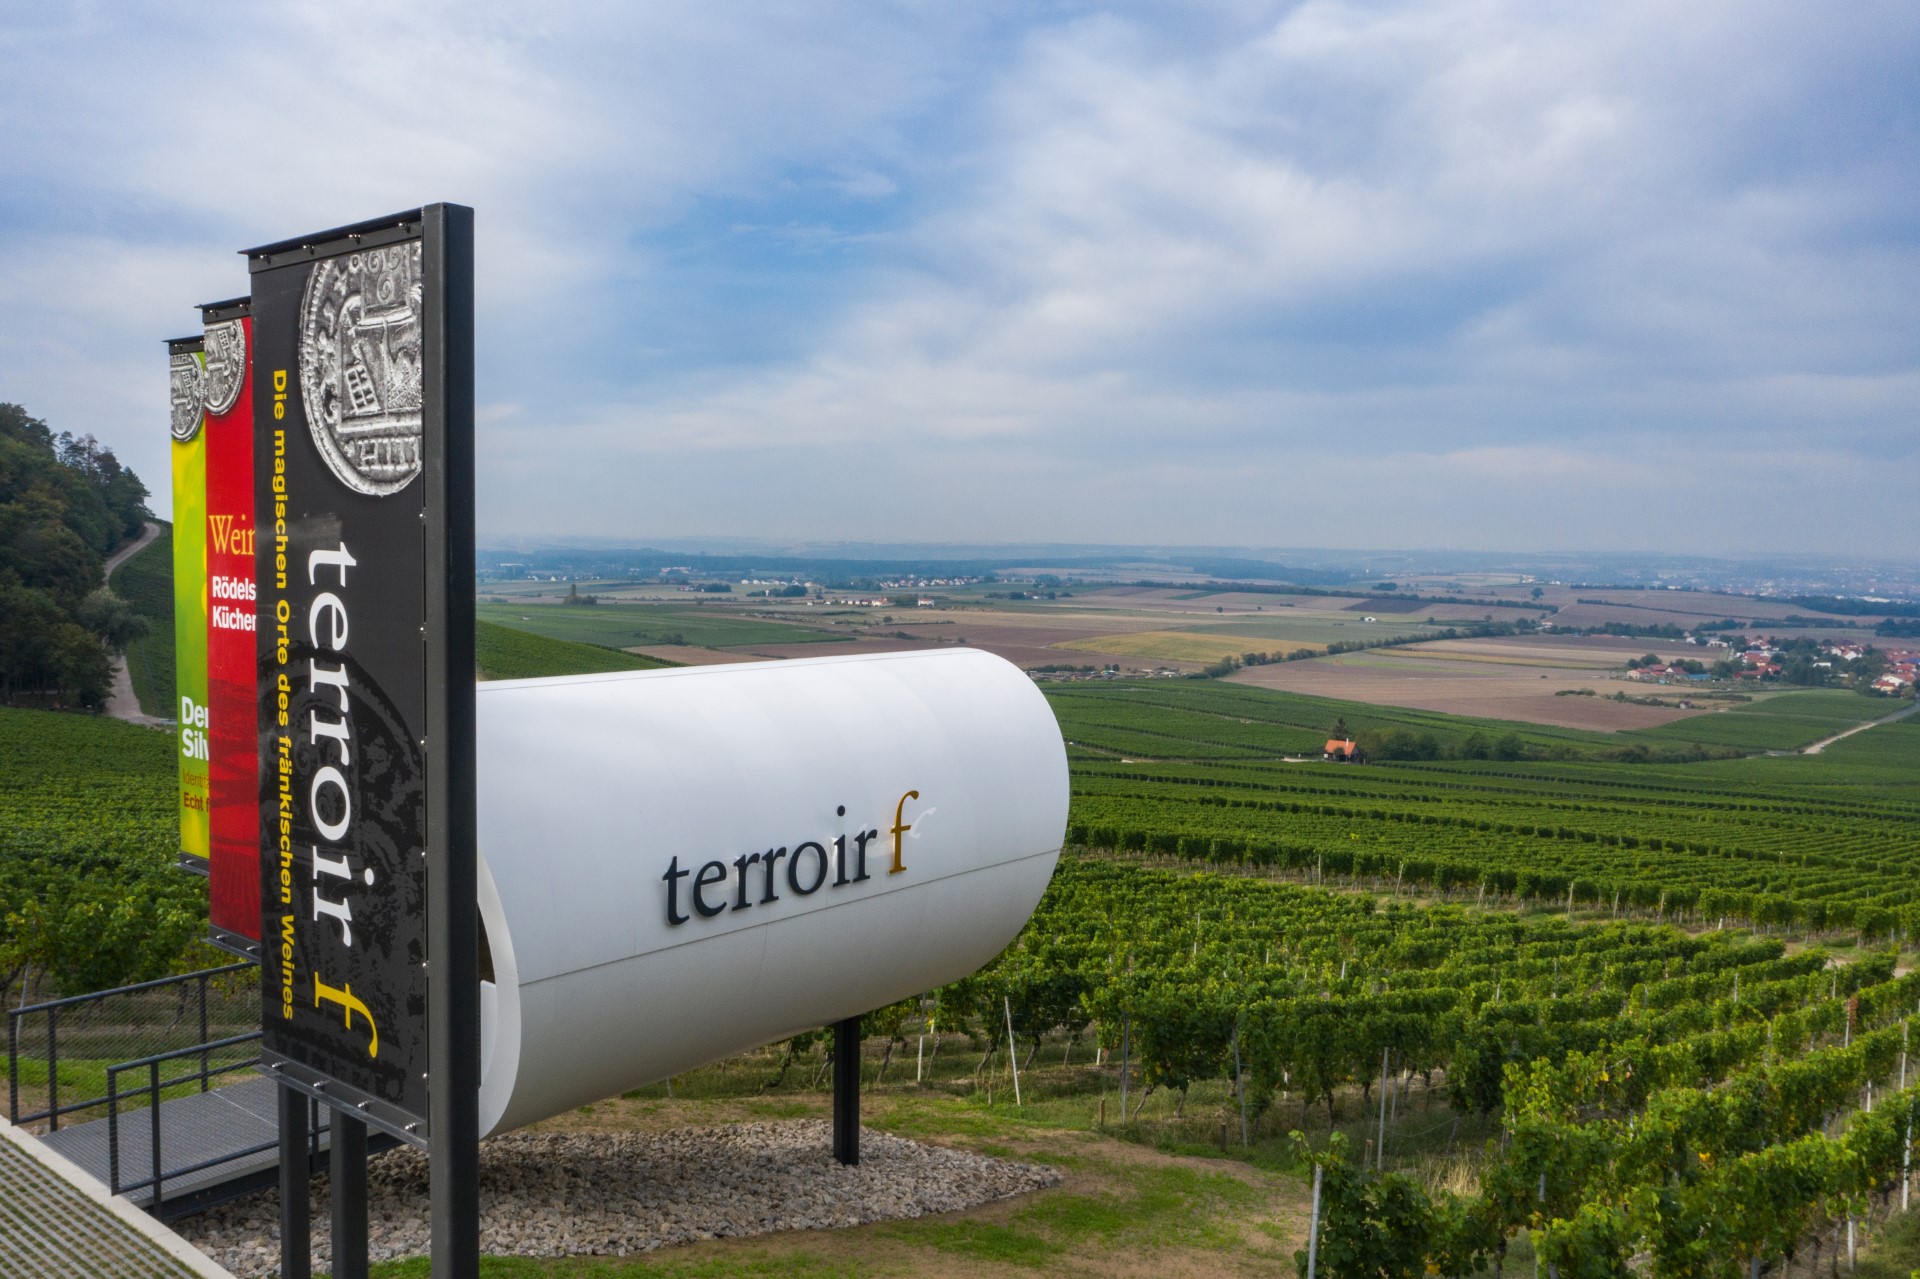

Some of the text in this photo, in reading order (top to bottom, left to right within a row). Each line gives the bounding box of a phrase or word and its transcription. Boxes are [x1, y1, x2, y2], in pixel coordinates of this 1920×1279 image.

[212, 575, 256, 602] Rödels
[271, 368, 295, 1019] Die magischen Orte des fränkischen Weines
[183, 791, 204, 812] Echt
[307, 541, 379, 1058] terroir f
[662, 790, 920, 926] terroir f
